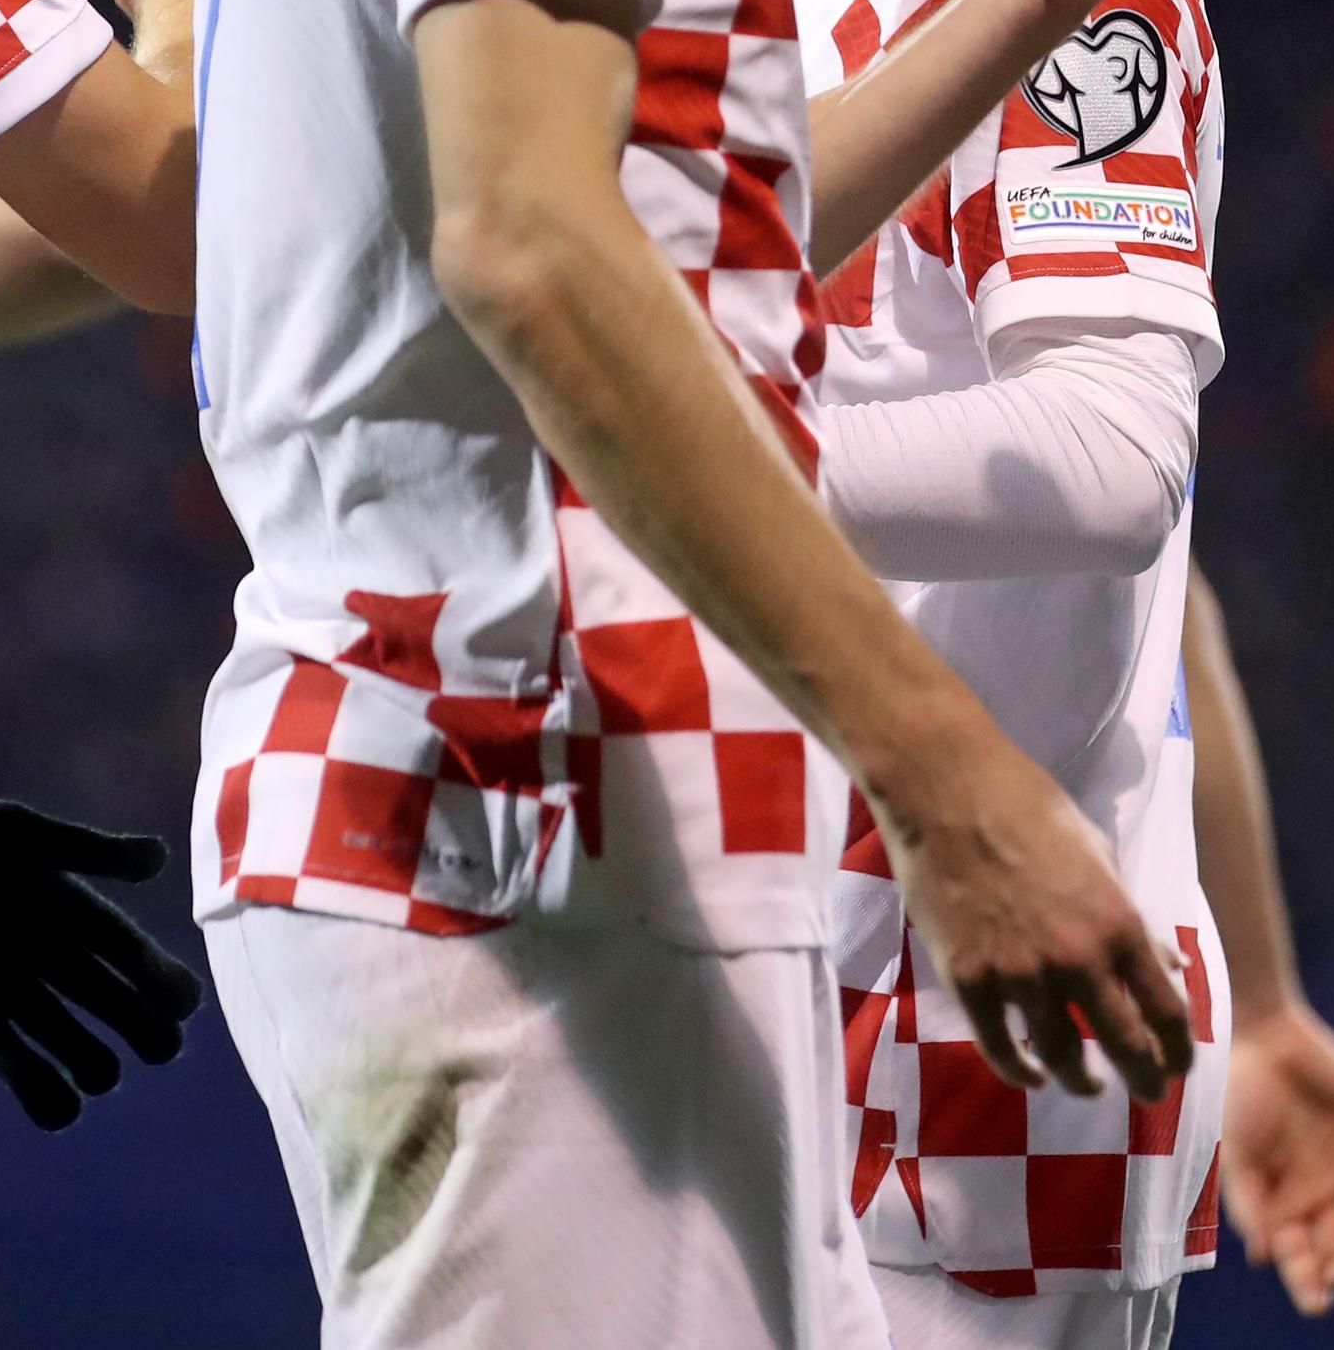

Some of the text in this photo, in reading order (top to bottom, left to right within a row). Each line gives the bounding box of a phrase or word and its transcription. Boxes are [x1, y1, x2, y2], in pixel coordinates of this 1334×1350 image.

[1007, 185, 1051, 203] UEFA
[1008, 199, 1192, 230] FOUNDATION
[1142, 226, 1194, 247] for children
